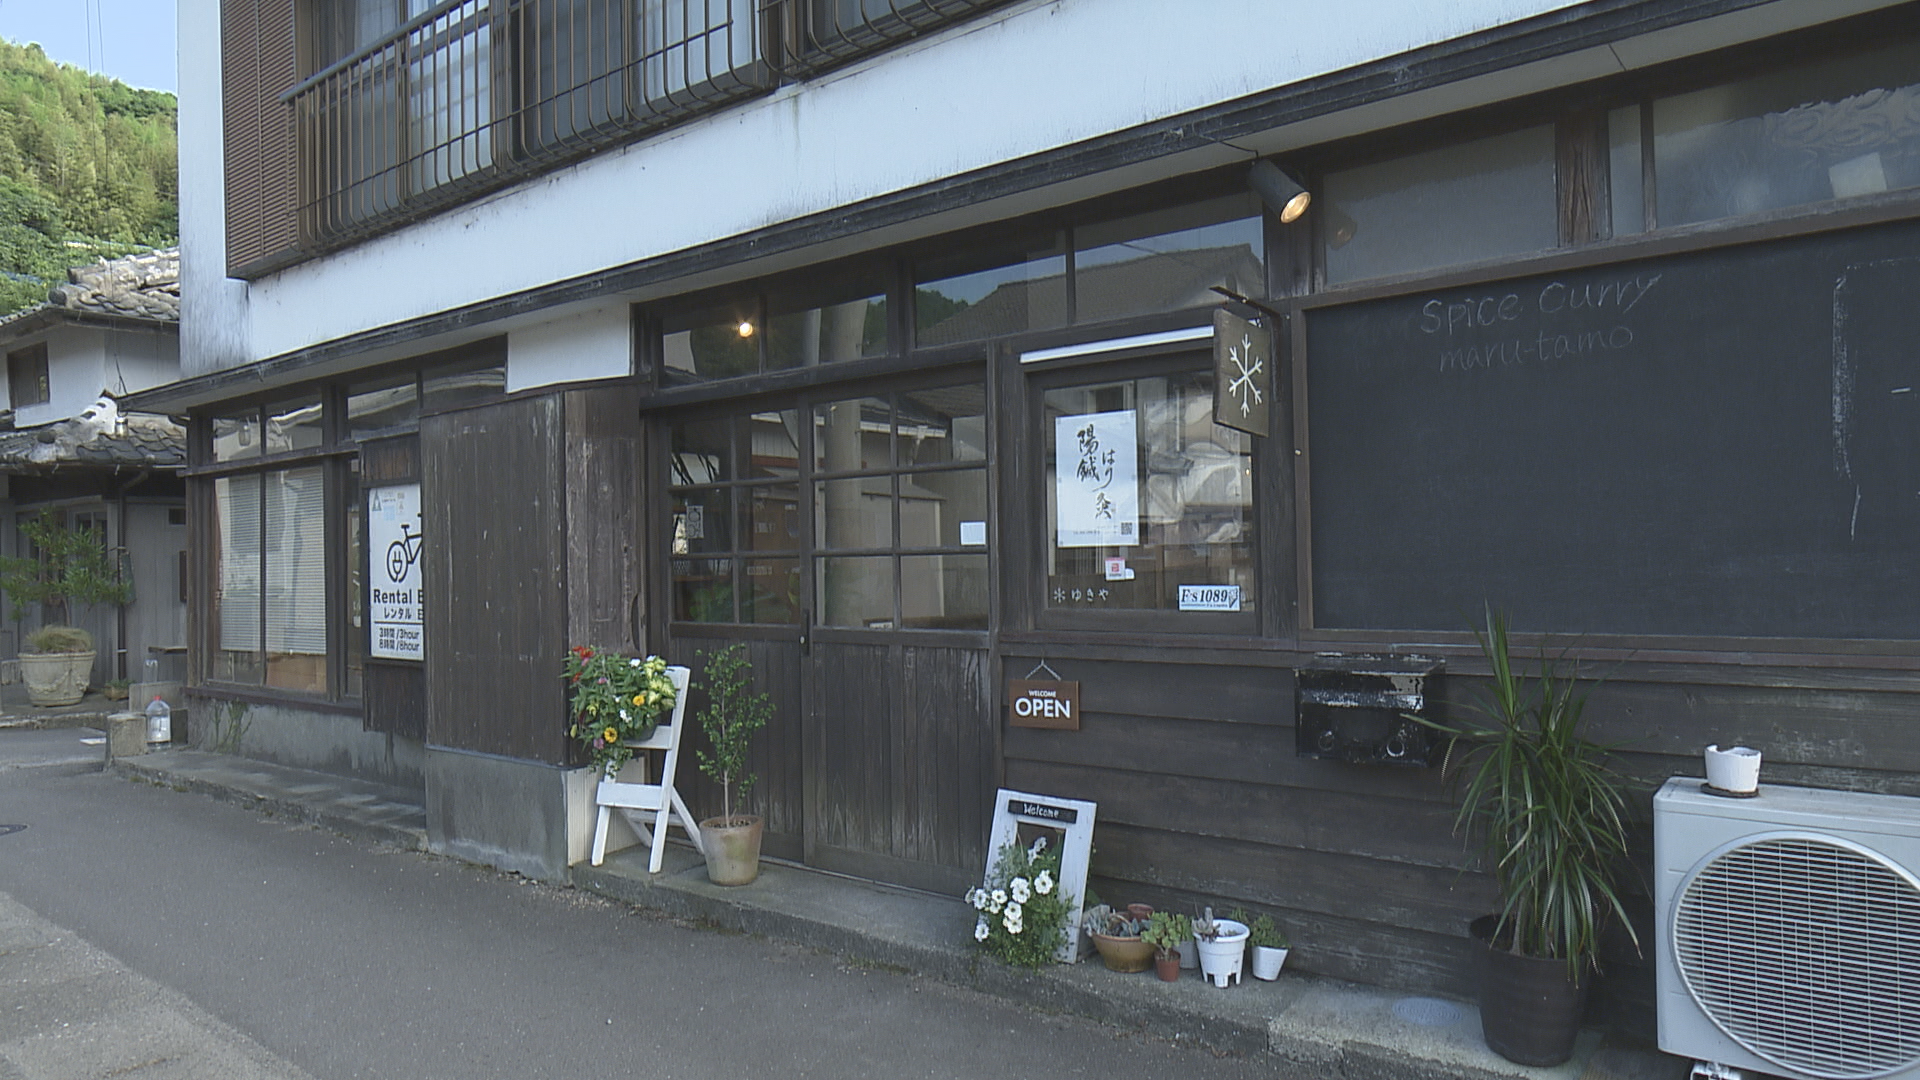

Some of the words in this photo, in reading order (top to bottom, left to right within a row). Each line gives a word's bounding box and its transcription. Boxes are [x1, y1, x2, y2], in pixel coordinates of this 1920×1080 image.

[1421, 294, 1519, 335] Spice
[1539, 273, 1662, 314] Curry
[373, 588, 412, 604] Rental
[1071, 587, 1109, 602] ゆきや
[1199, 589, 1228, 603] 1089
[384, 607, 412, 619] レンタル
[1028, 690, 1056, 698] WELCOME
[1015, 697, 1071, 719] OPEN
[1023, 802, 1060, 819] Welcome
